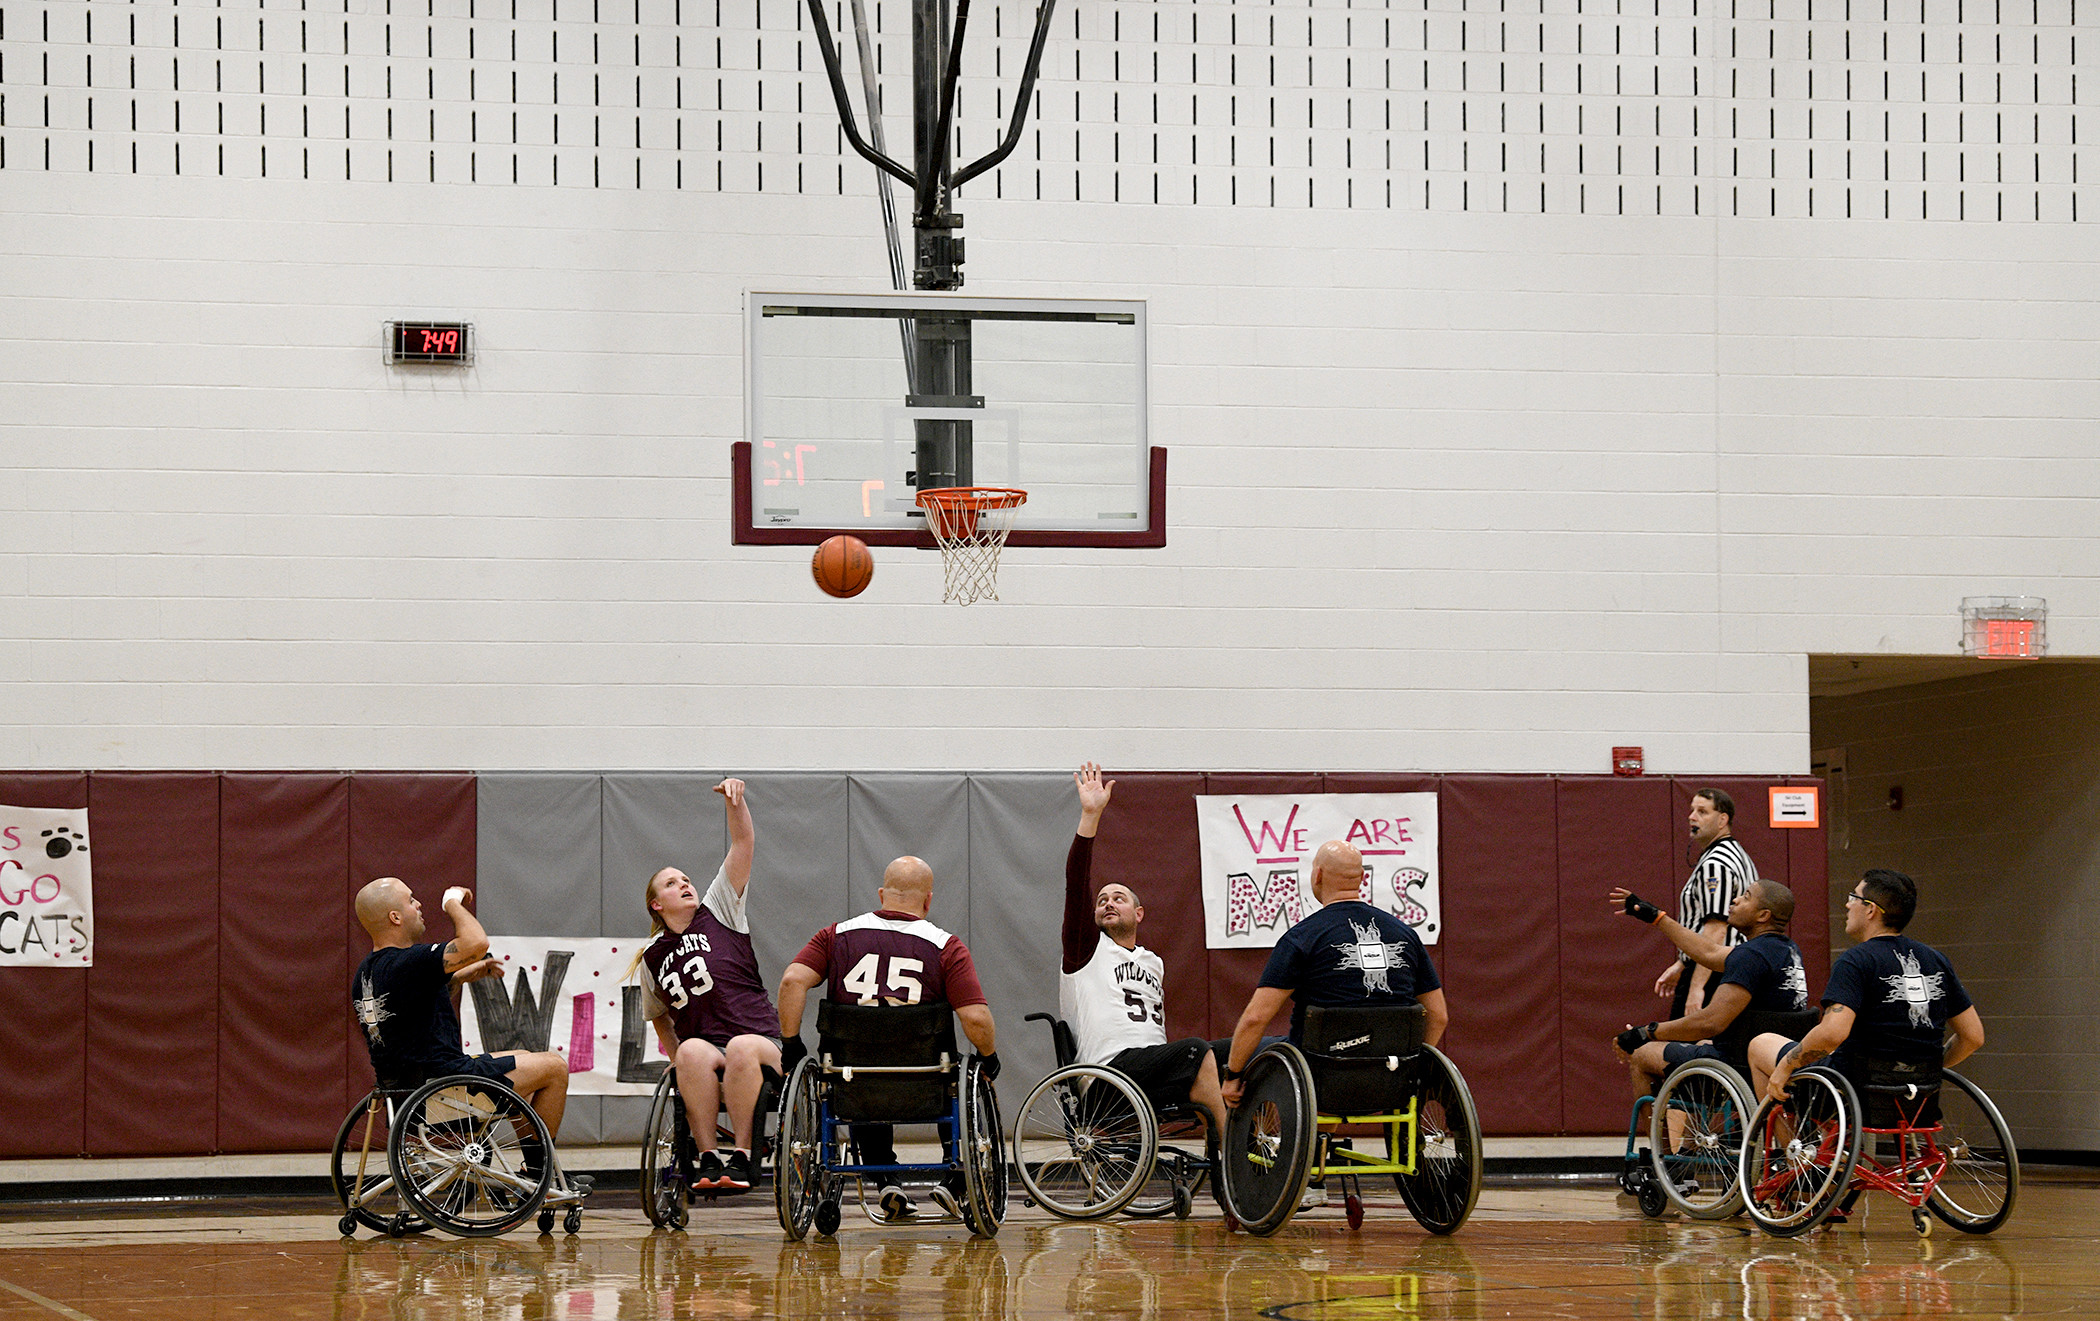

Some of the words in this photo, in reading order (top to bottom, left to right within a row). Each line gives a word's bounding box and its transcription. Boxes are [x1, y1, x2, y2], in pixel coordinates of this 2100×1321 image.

[420, 330, 458, 353] 7:49
[1987, 621, 2034, 656] EXIT
[1346, 817, 1414, 845] ARE
[0, 859, 61, 906] GO
[662, 955, 714, 1010] 33
[843, 953, 924, 1007] 45
